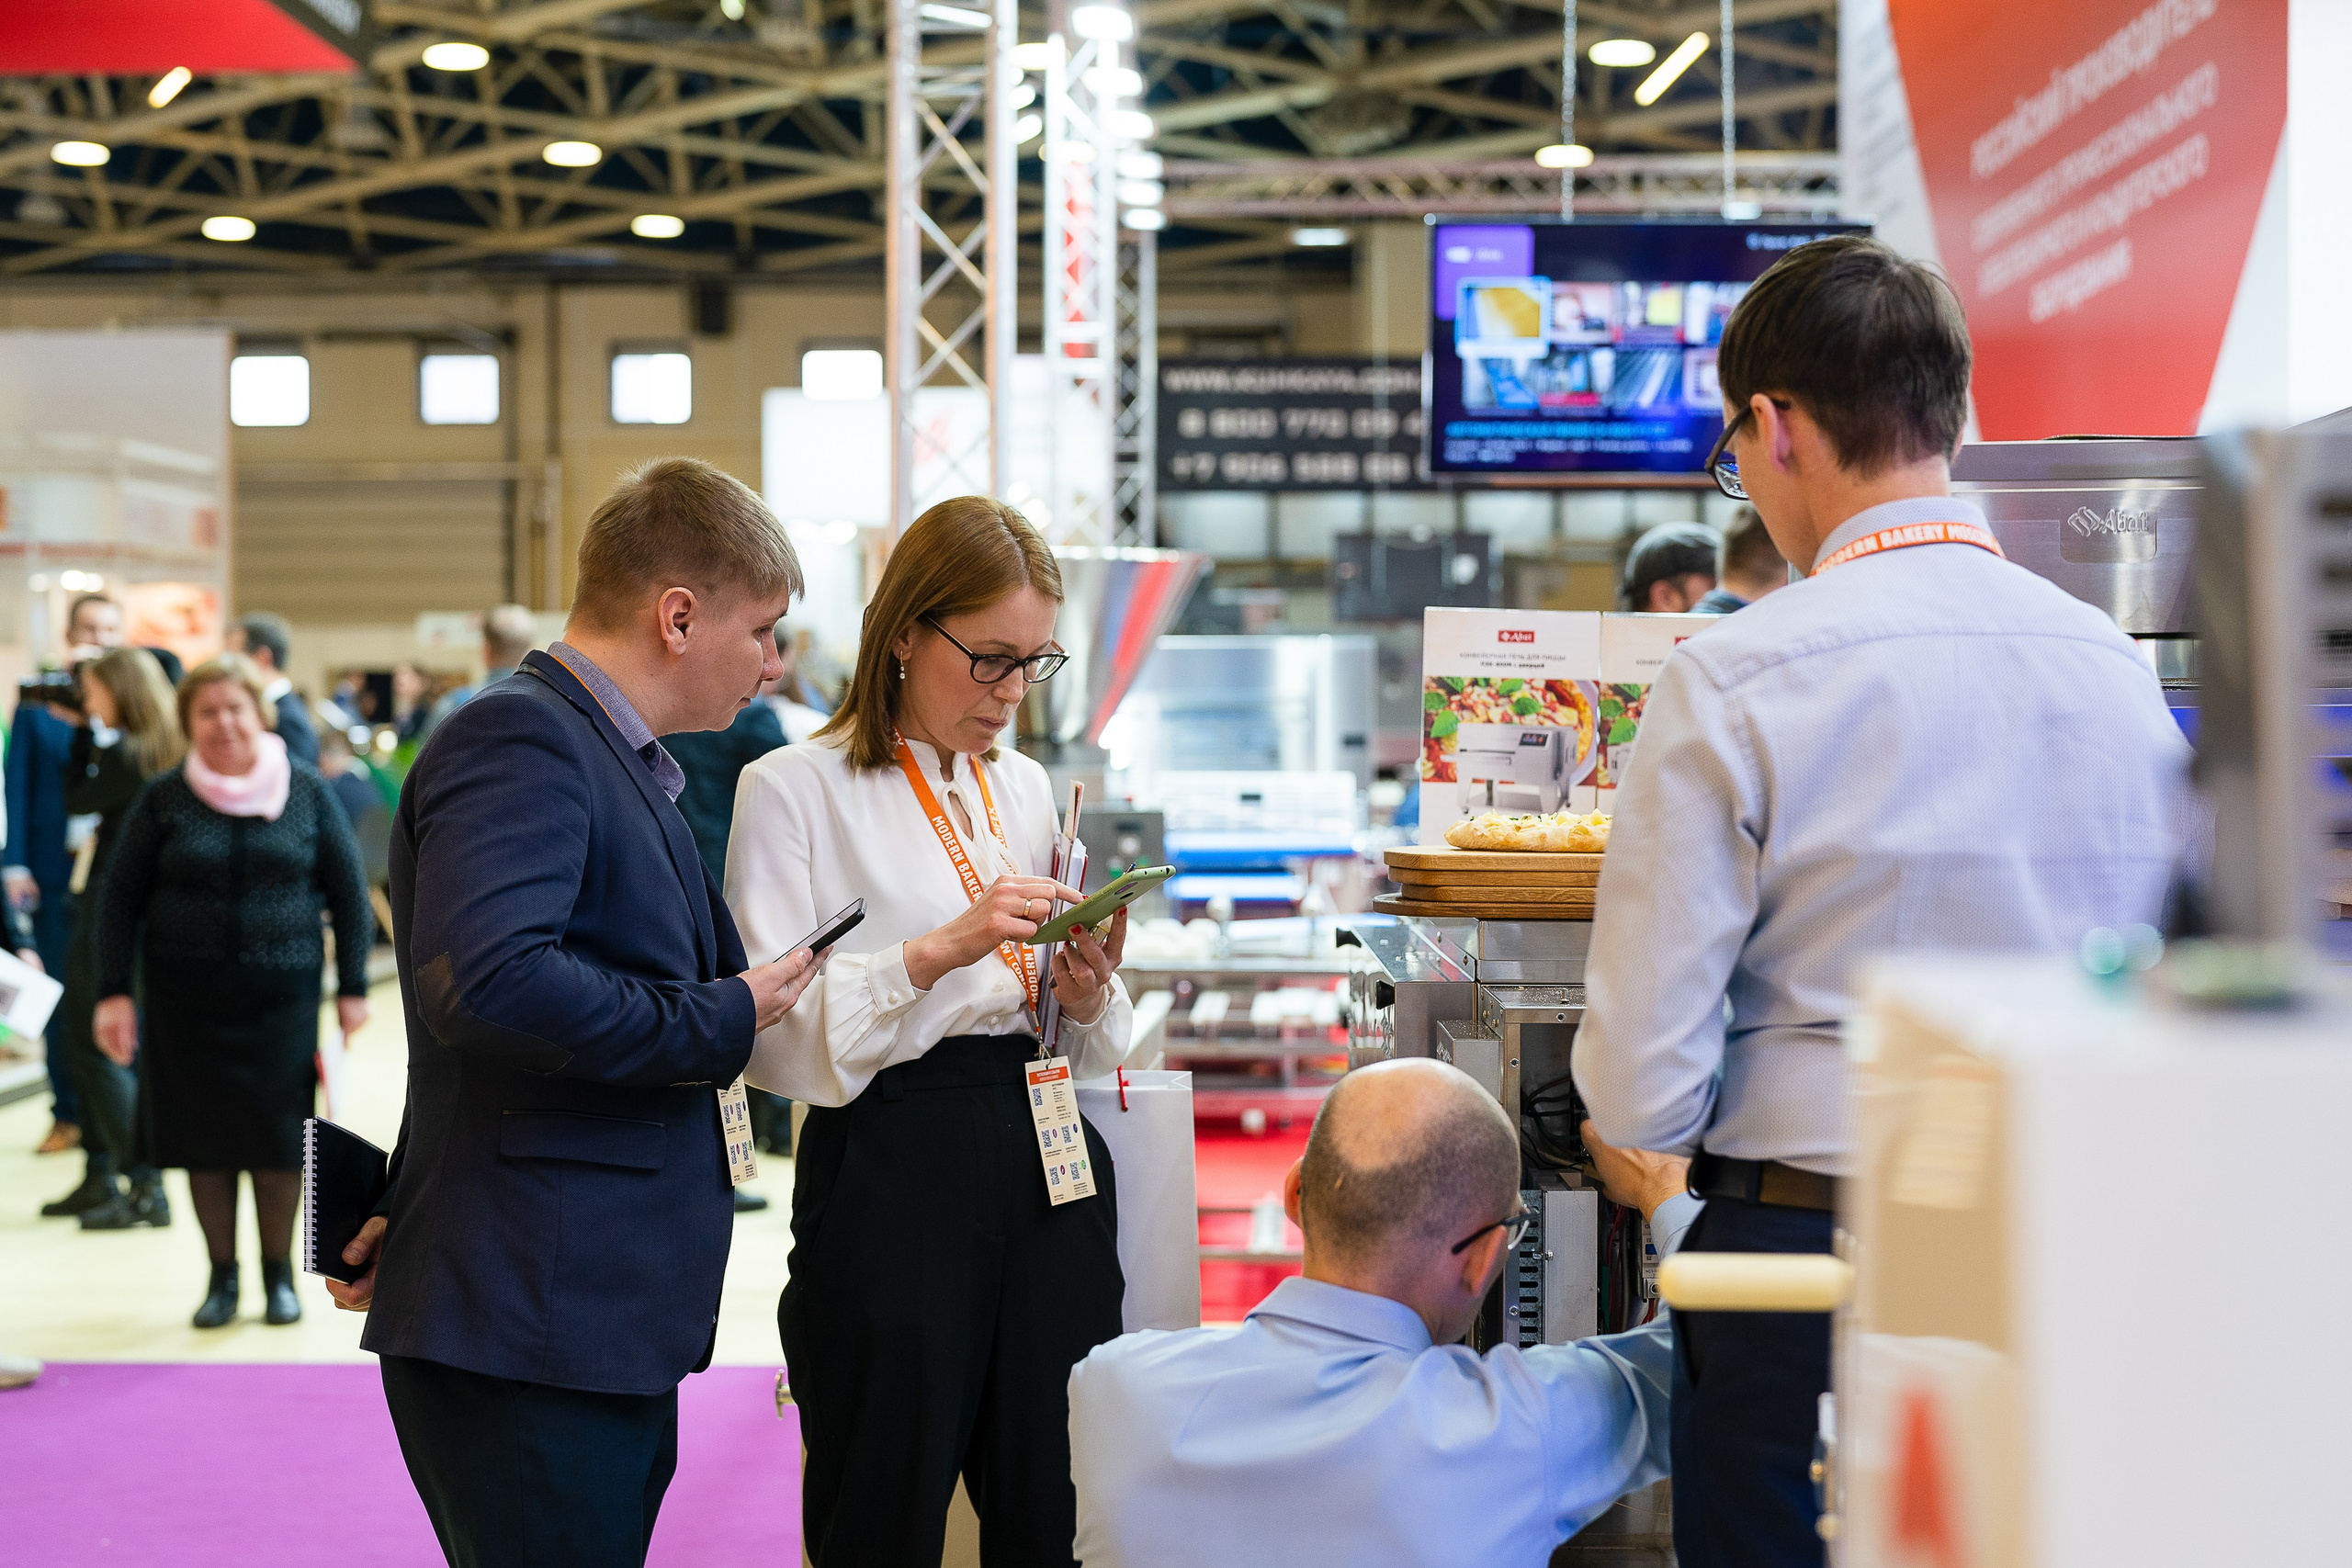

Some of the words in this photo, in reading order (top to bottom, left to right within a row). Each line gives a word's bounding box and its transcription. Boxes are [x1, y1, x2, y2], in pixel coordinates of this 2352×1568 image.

[1879, 523, 1945, 548] BAKERY
[932, 815, 965, 863] MODERN
[957, 861, 984, 903] BAKER
[1023, 953, 1038, 1003] MODERN
